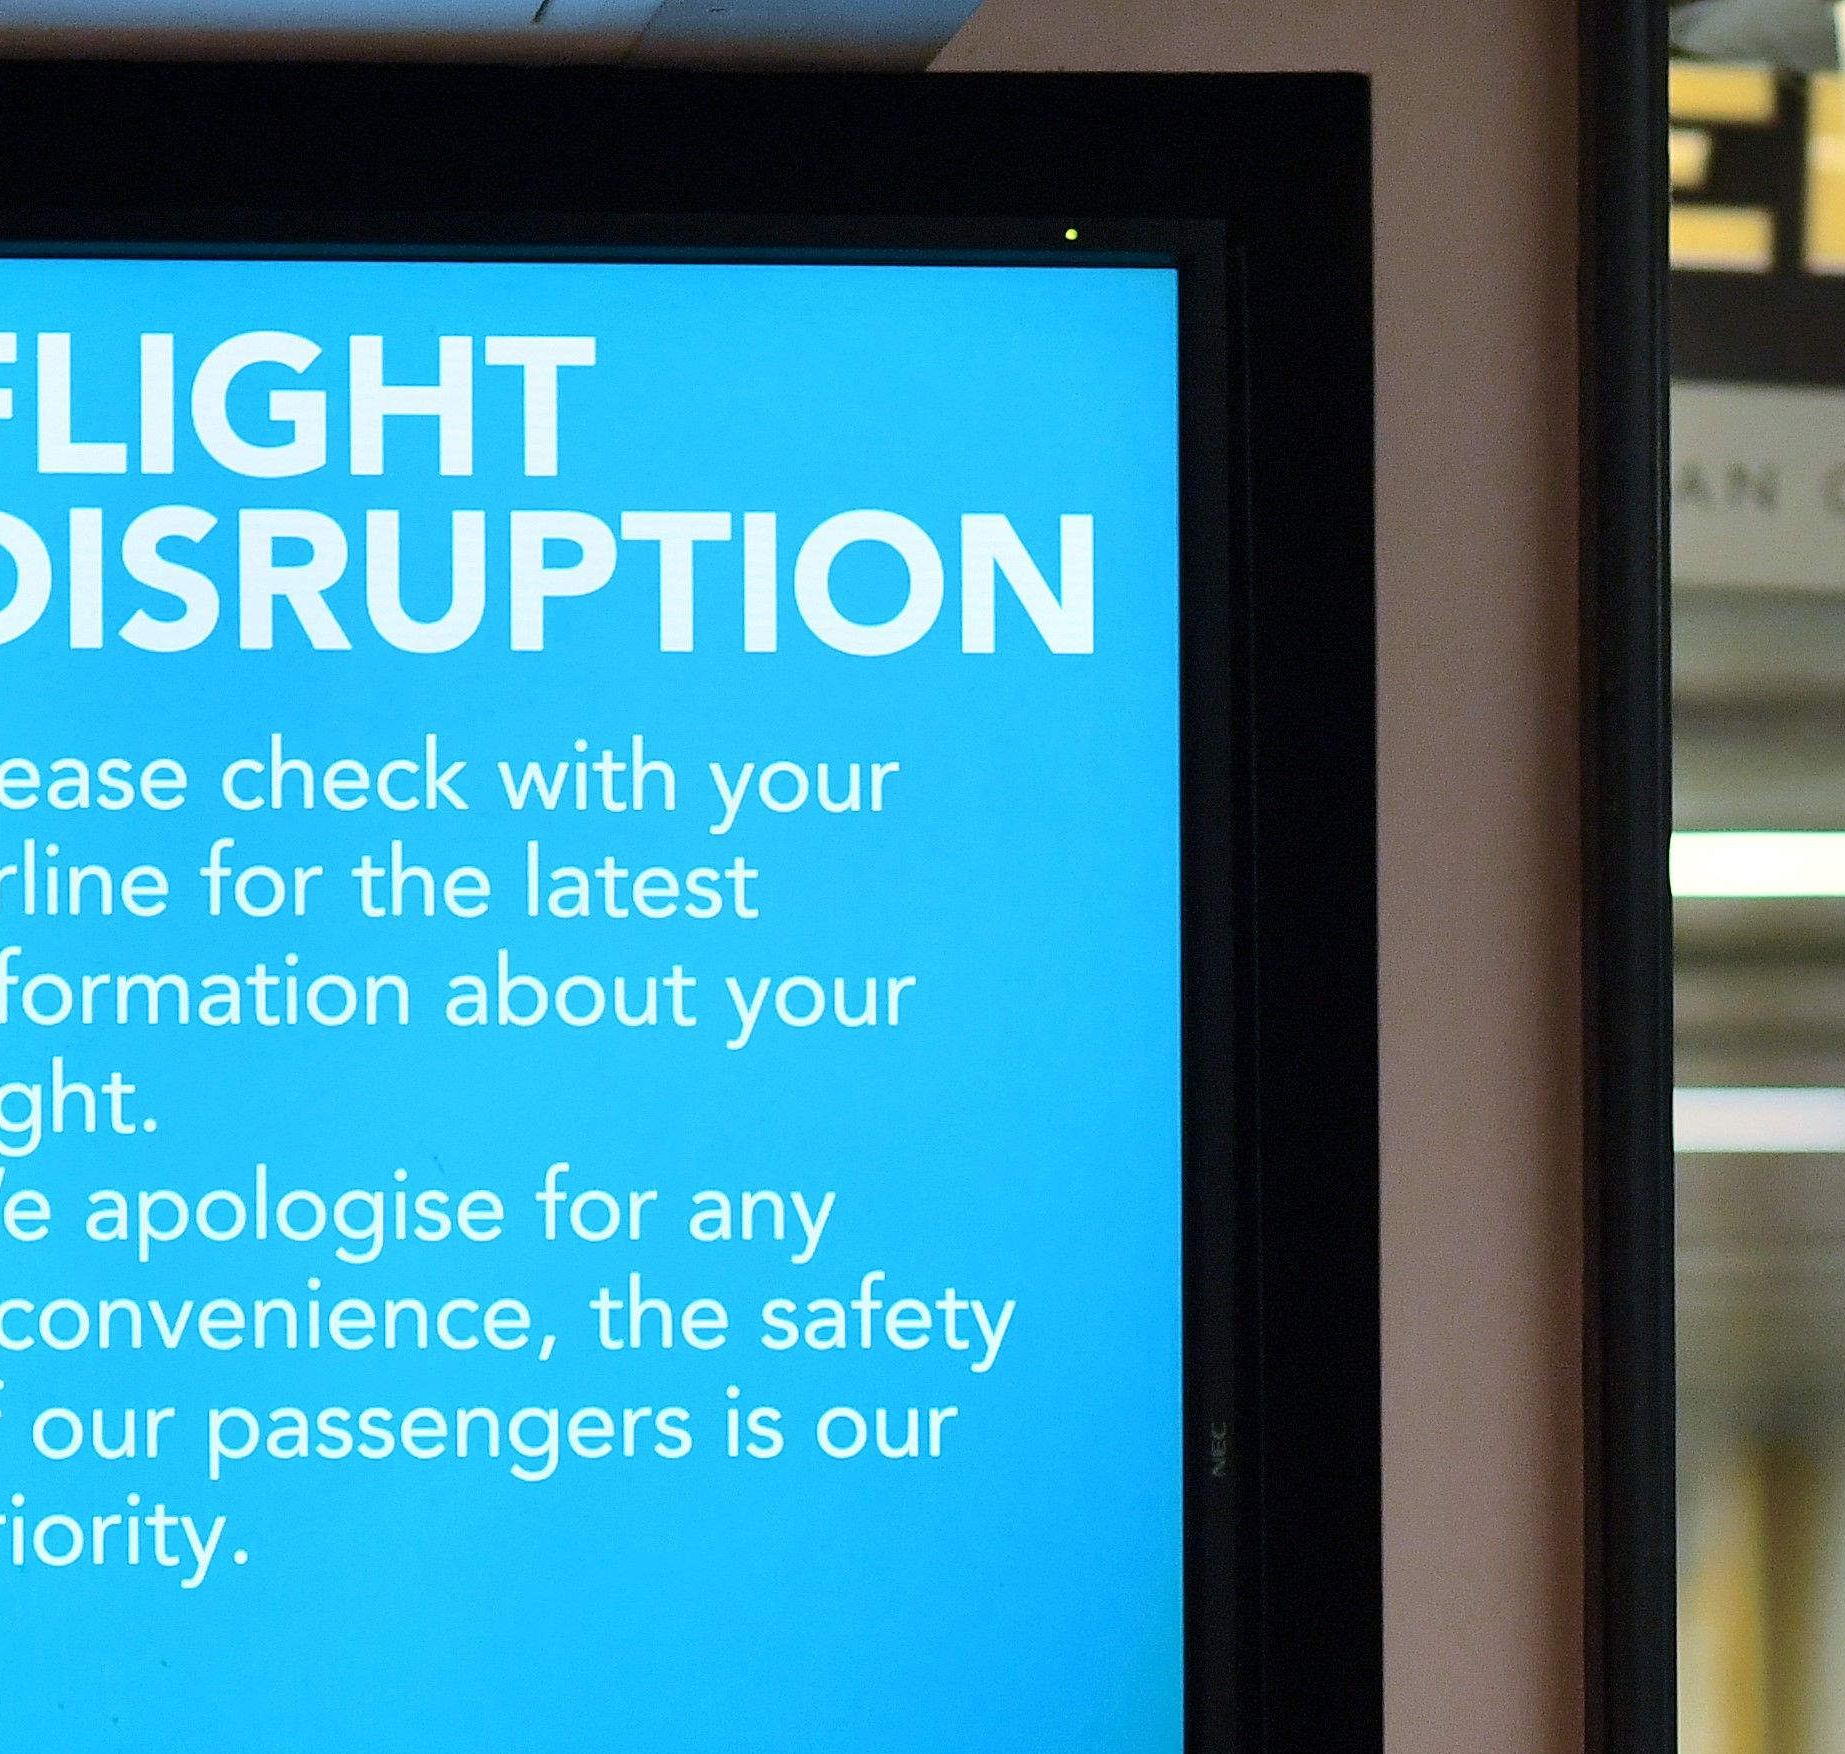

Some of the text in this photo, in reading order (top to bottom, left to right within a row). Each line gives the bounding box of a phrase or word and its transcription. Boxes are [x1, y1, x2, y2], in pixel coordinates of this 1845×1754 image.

[221, 732, 470, 812] check
[496, 733, 677, 813] with
[708, 760, 901, 836] your
[199, 837, 324, 918] for
[350, 838, 492, 919] the
[526, 839, 760, 920] latest
[445, 948, 698, 1028] about
[725, 975, 918, 1051] your
[85, 1162, 505, 1265] apologise
[534, 1161, 659, 1243] for
[689, 1189, 837, 1265] any
[588, 1271, 729, 1351] the
[761, 1270, 1017, 1374] safety
[32, 1406, 176, 1461] our
[208, 1406, 693, 1483] passengers
[725, 1384, 785, 1460] is
[816, 1406, 959, 1460] our
